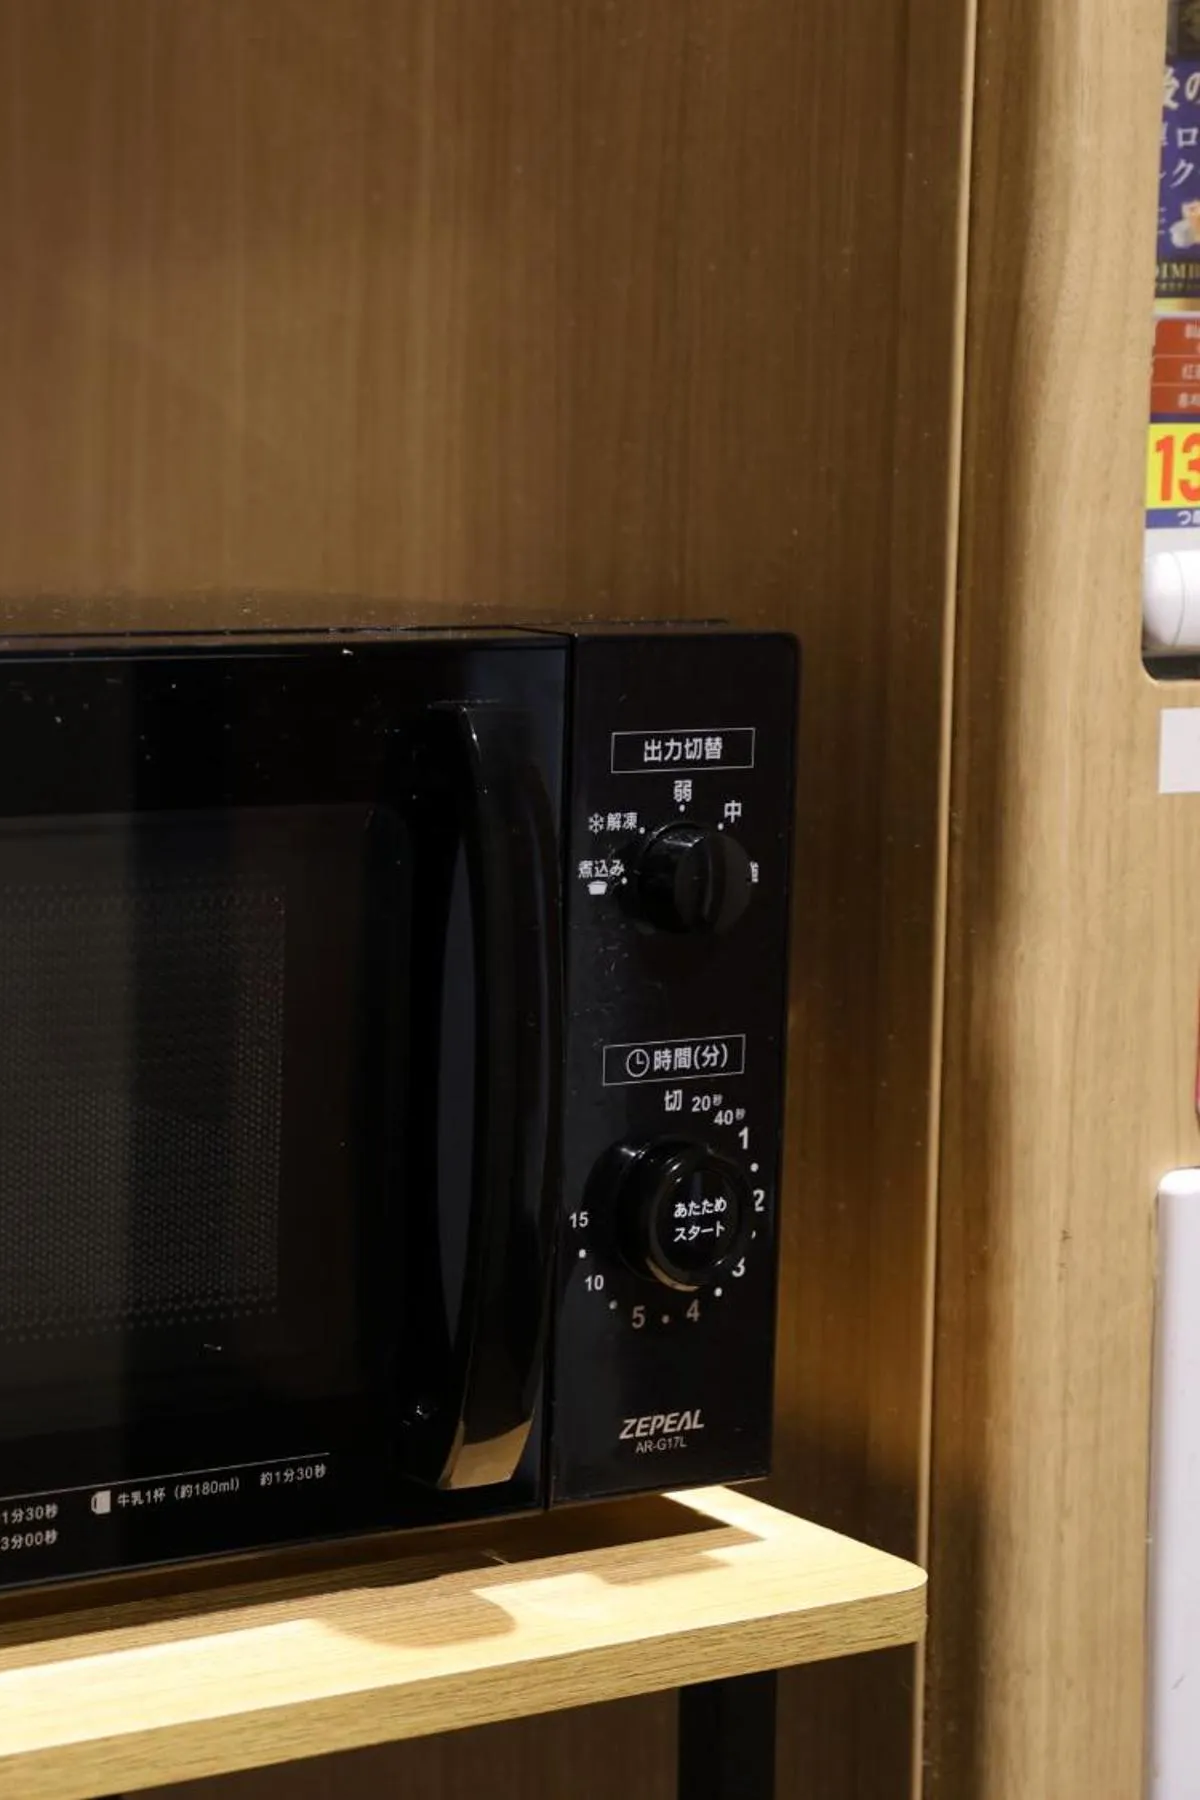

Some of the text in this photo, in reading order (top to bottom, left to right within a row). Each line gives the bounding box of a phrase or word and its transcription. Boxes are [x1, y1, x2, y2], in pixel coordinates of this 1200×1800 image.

[643, 736, 723, 763] 出力切替
[673, 779, 693, 803] 弱
[606, 811, 639, 831] 解凍
[723, 799, 742, 823] 中
[578, 859, 625, 879] 煮込み
[663, 1088, 683, 1112] 切
[738, 1126, 749, 1150] 1
[673, 1196, 728, 1219] あたため
[752, 1188, 765, 1213] 2
[569, 1210, 589, 1229] 15
[673, 1220, 726, 1243] スタート
[584, 1274, 605, 1292] 10
[631, 1305, 646, 1329] 5
[686, 1298, 701, 1322] 4
[618, 1408, 705, 1440] ZEPEAL
